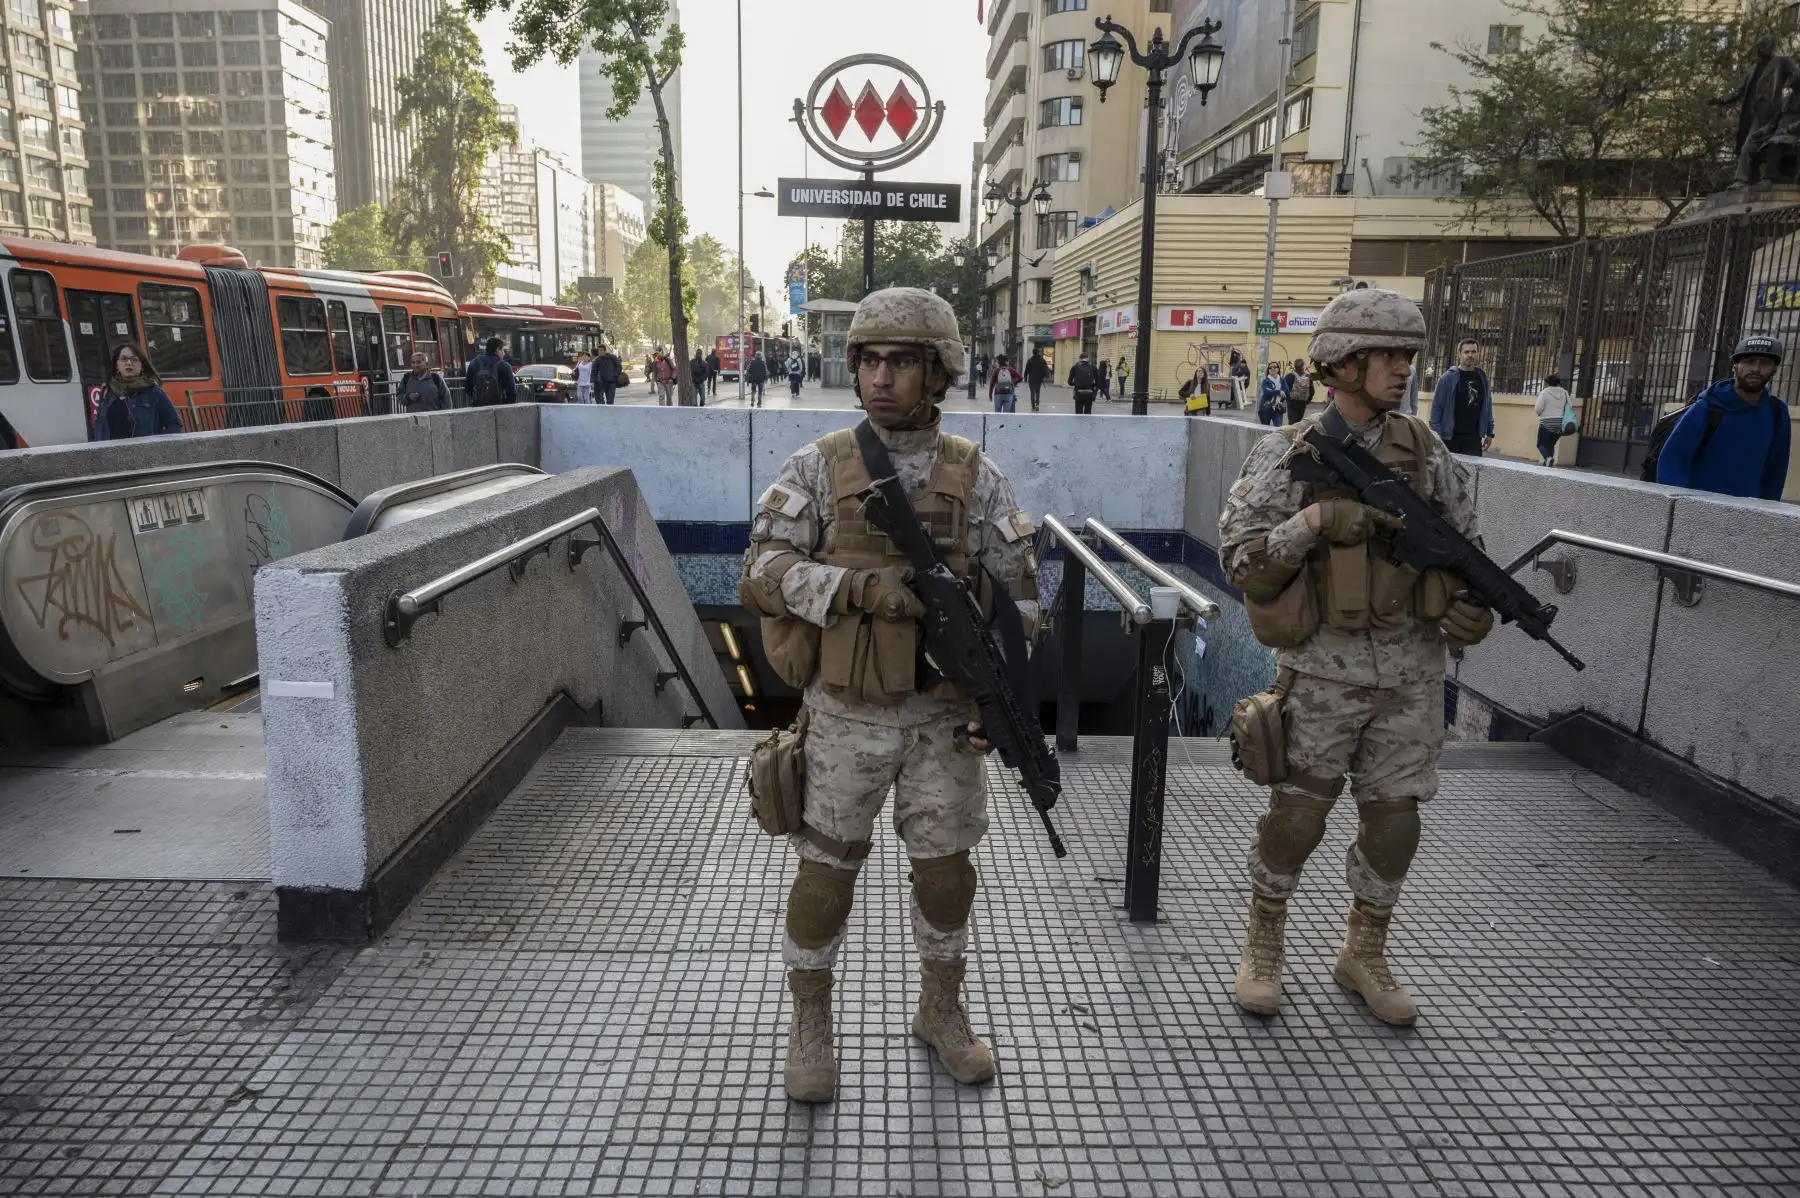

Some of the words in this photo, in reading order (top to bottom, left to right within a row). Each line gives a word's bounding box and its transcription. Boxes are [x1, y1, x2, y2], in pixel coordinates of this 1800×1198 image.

[791, 189, 881, 206] UNIVERSIDAD
[887, 192, 904, 207] DE
[909, 193, 947, 208] CHILE
[1197, 316, 1238, 325] ahumada
[1288, 317, 1318, 326] ahuma
